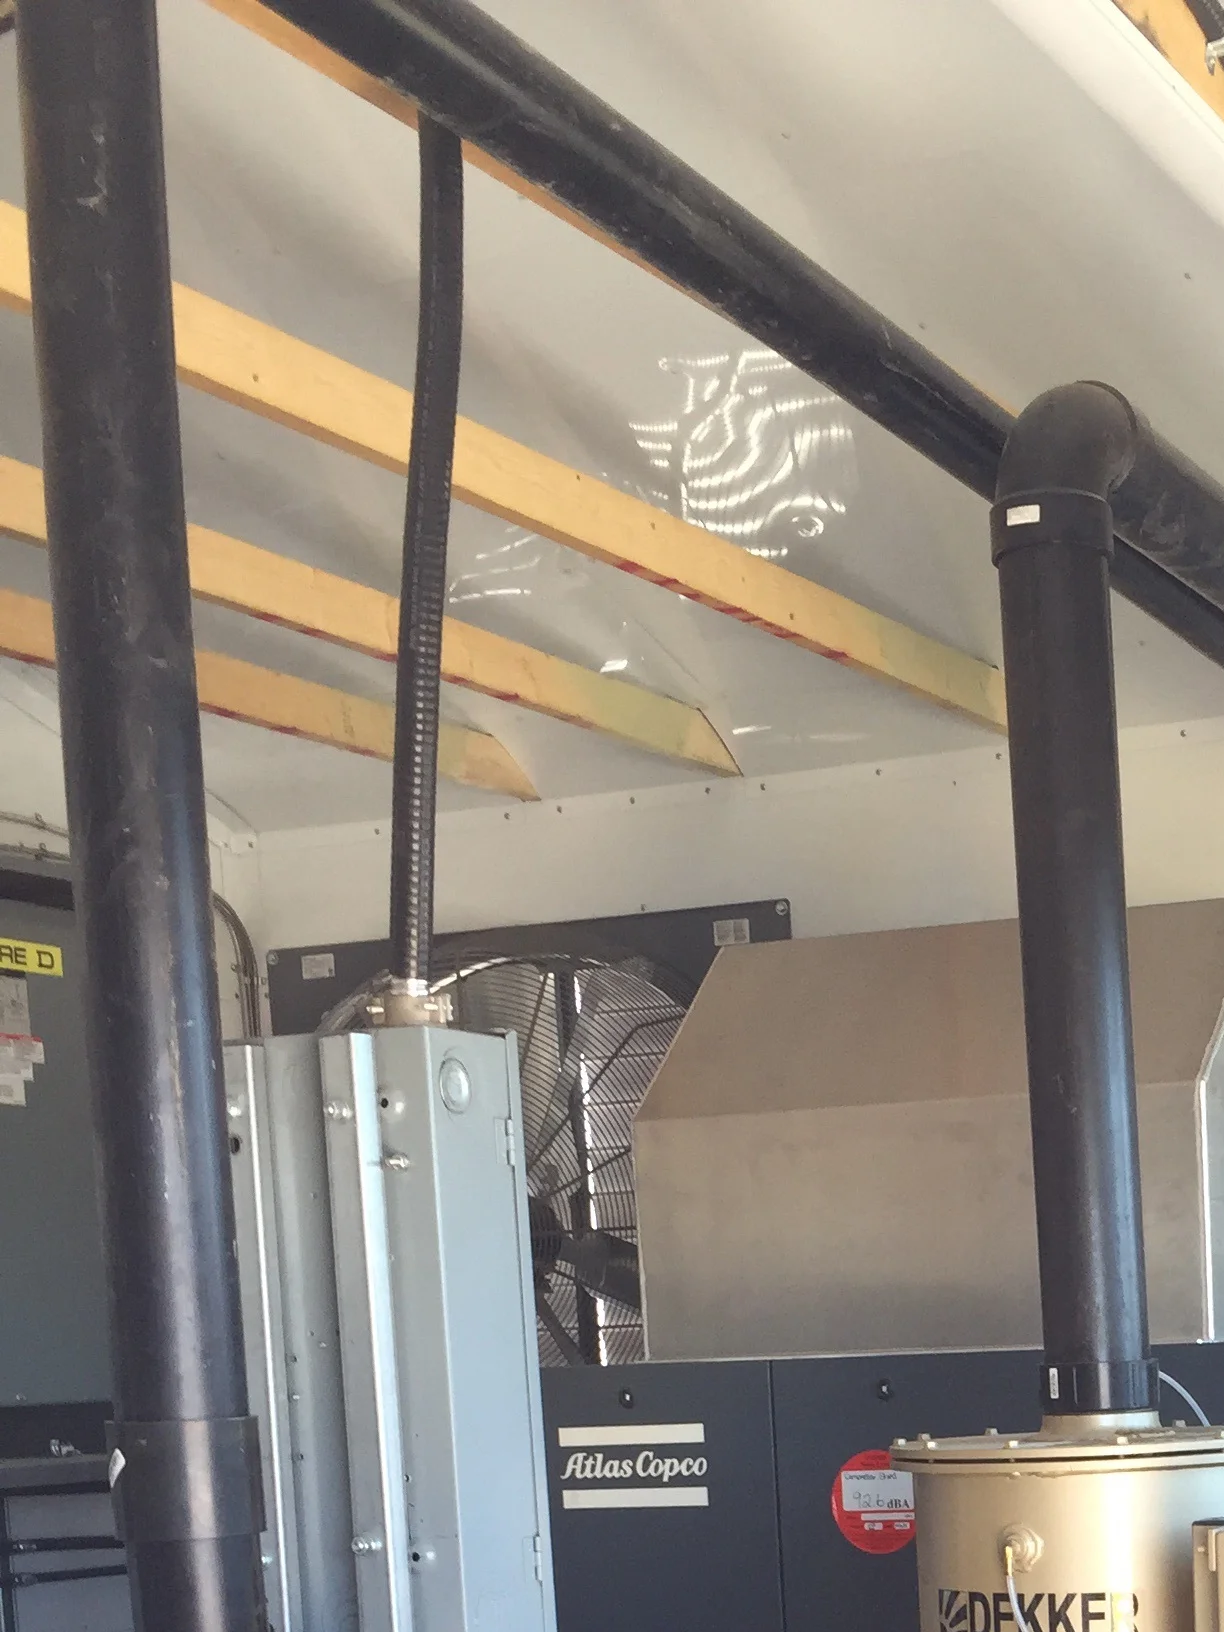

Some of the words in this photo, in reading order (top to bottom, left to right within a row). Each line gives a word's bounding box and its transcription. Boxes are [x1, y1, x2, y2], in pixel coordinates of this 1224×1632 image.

[36, 949, 54, 969] D
[560, 1452, 633, 1479] Atlas
[636, 1451, 708, 1482] Copco
[887, 1499, 910, 1509] dBA
